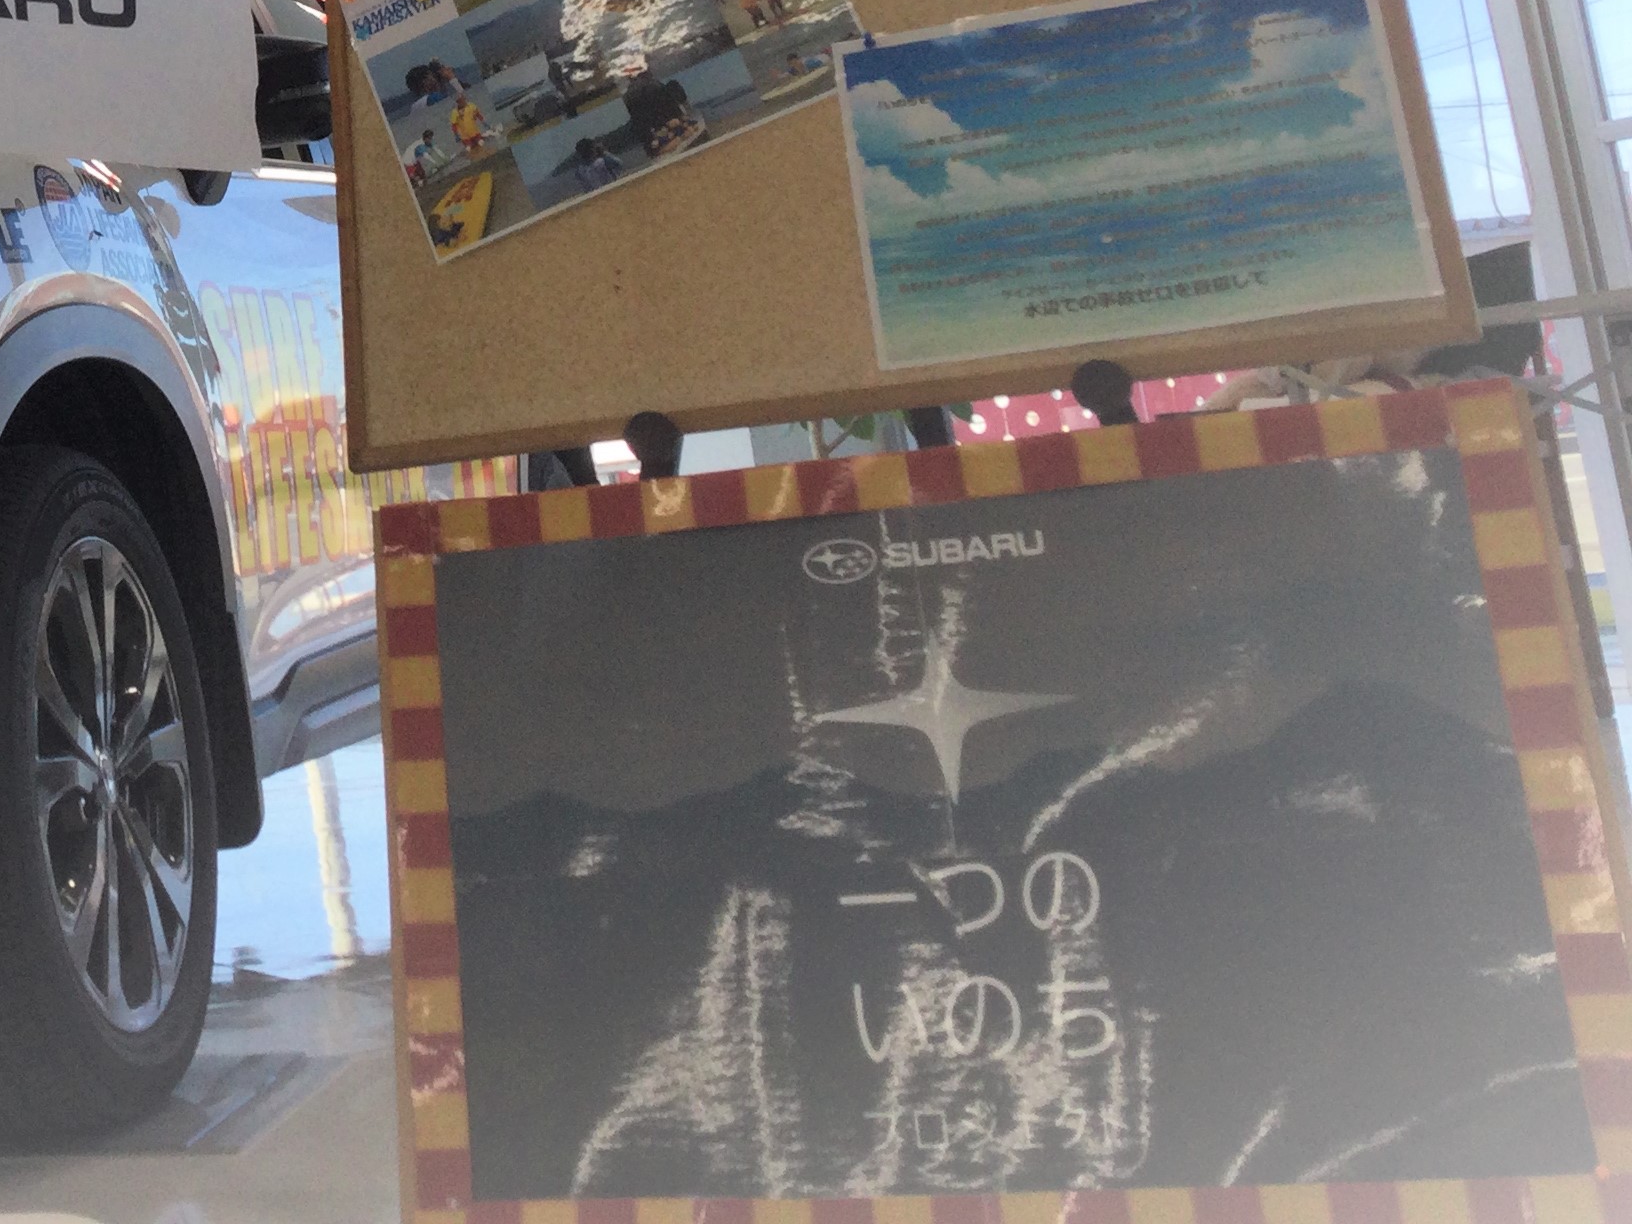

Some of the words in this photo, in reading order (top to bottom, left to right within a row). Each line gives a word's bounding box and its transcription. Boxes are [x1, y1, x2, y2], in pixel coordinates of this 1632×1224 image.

[881, 530, 1046, 569] SUBARU
[853, 975, 1117, 1063] いのち
